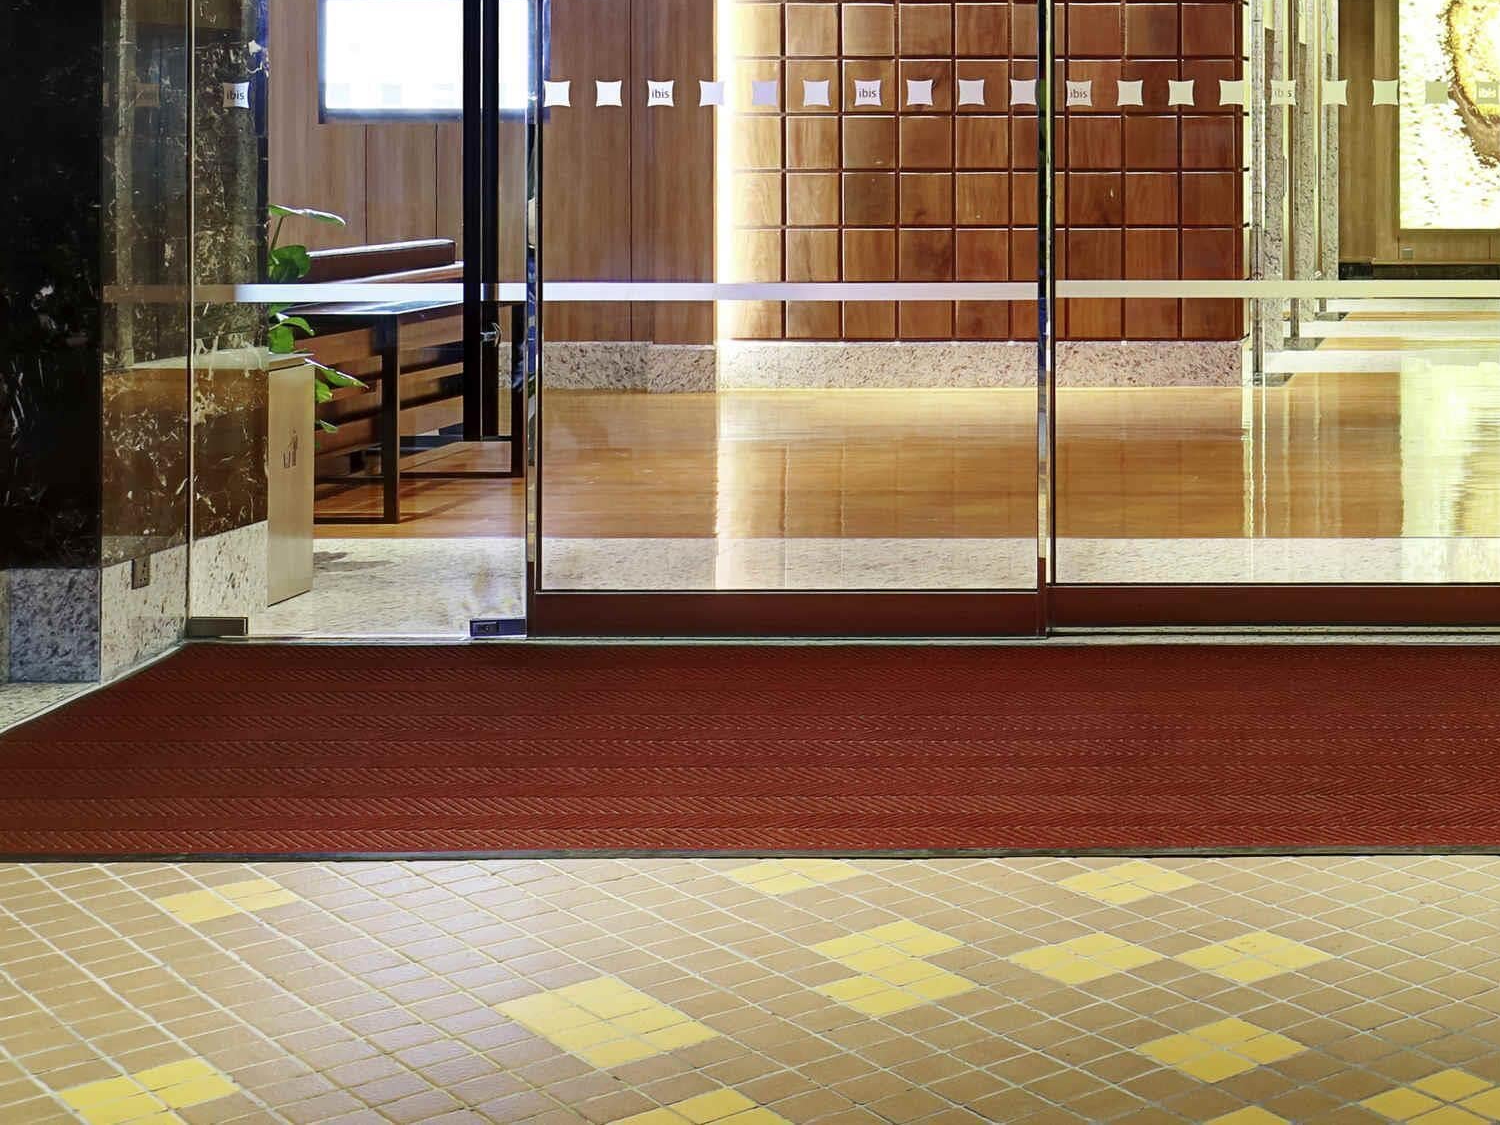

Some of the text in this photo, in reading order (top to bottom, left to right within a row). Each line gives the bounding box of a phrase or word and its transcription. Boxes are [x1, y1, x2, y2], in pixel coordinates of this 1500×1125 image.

[226, 89, 245, 101] ibis
[651, 88, 670, 98] ibis
[858, 88, 877, 98] ibis
[1069, 88, 1088, 98] ibis
[1274, 87, 1292, 98] ibs
